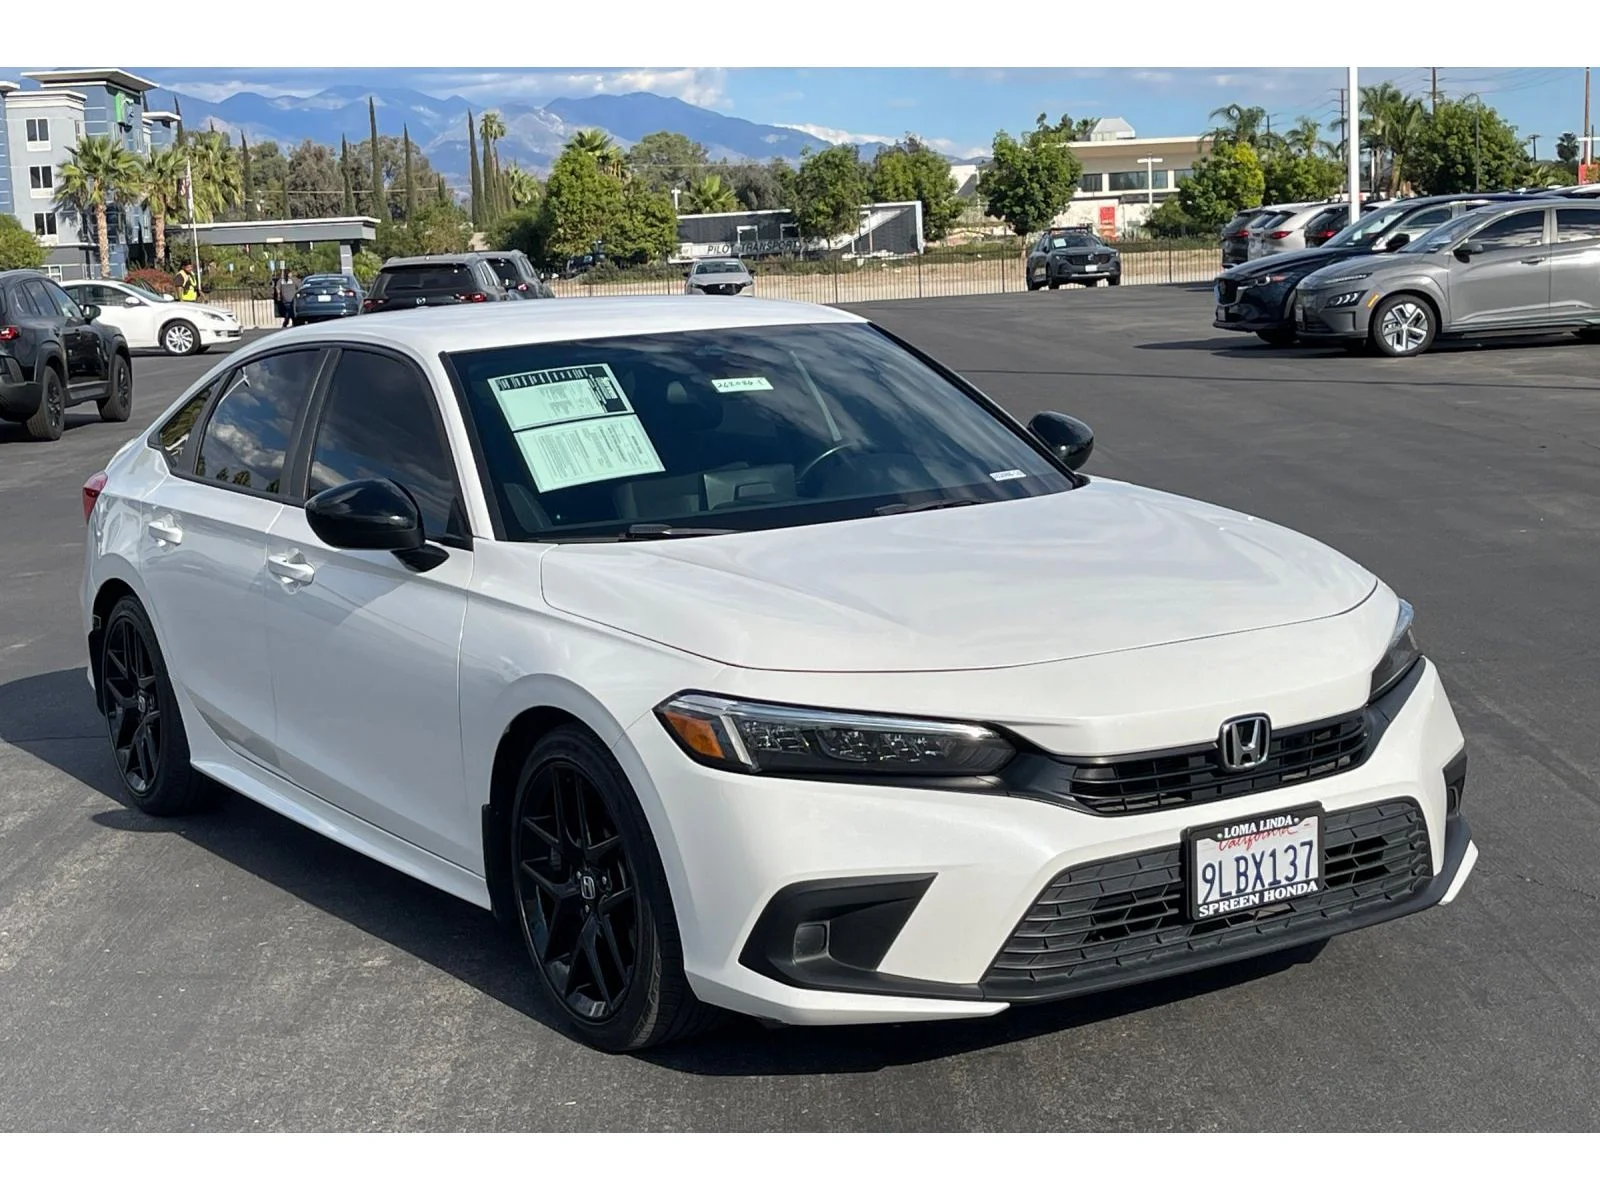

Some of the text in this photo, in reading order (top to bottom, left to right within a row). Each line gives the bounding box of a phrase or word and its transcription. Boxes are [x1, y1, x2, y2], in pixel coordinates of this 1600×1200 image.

[1224, 815, 1293, 839] LOMA LINDA
[1201, 839, 1314, 904] 9LBX137
[1198, 880, 1319, 918] SPREEN HONDA
